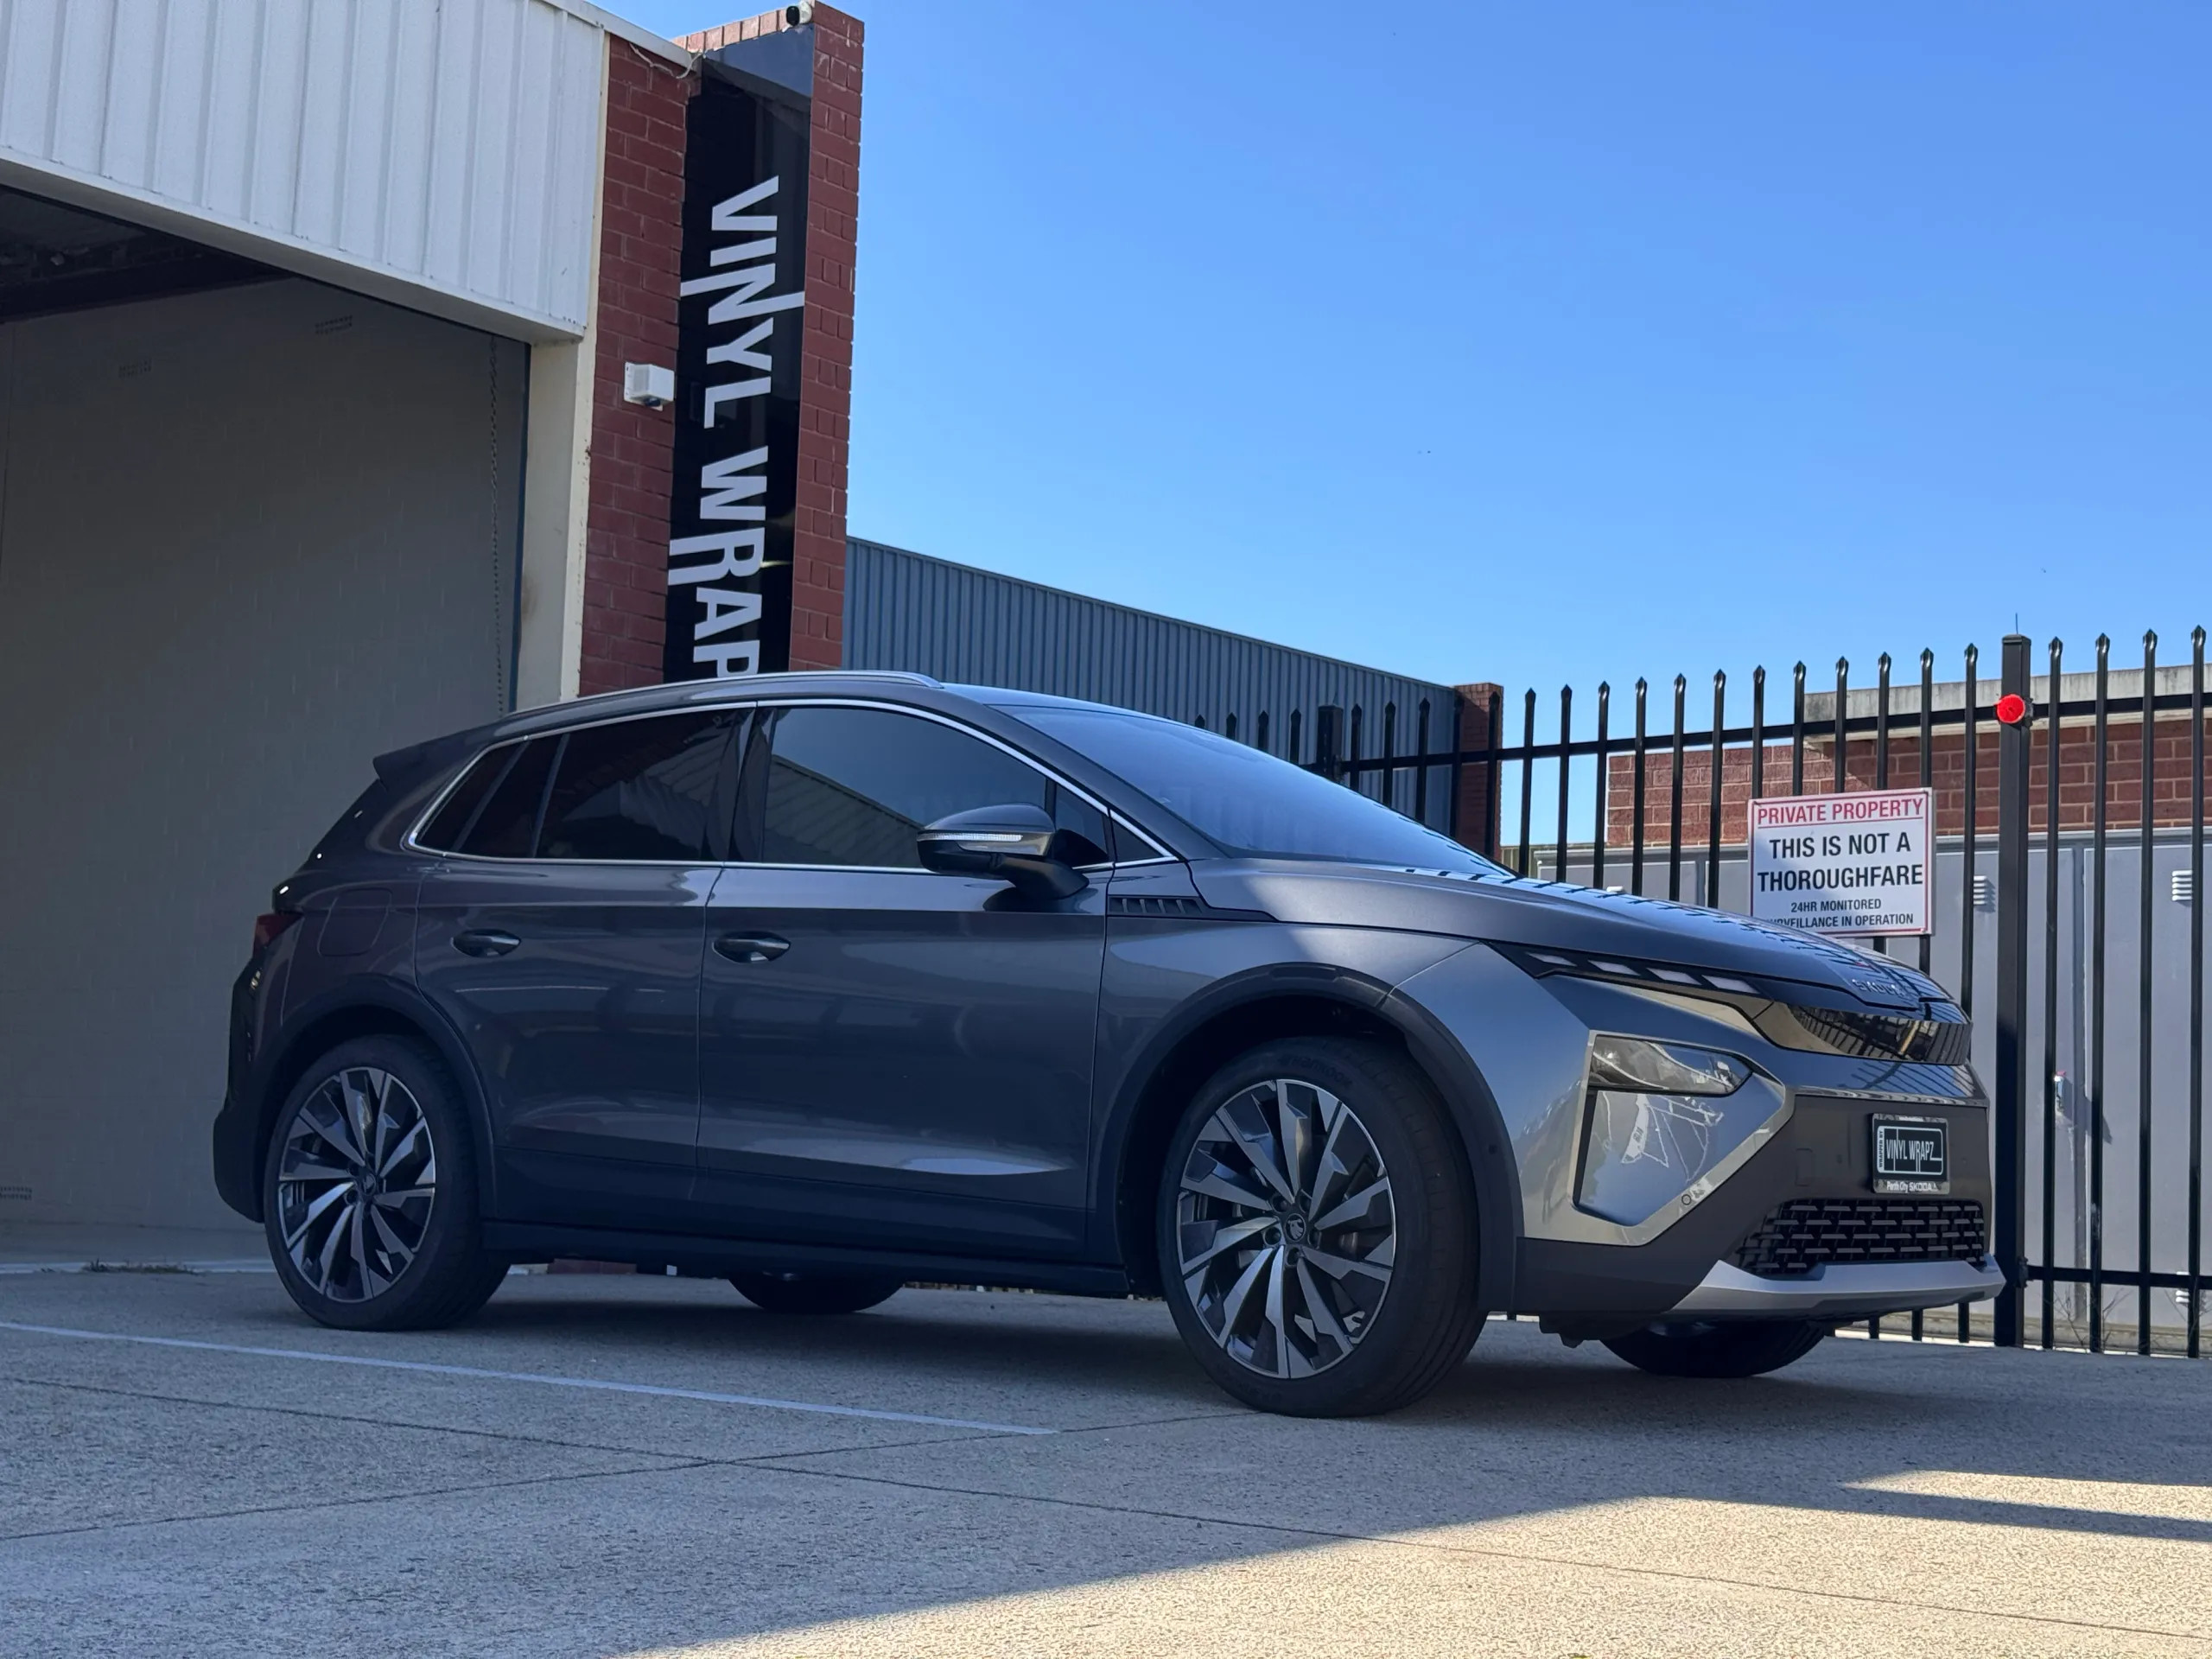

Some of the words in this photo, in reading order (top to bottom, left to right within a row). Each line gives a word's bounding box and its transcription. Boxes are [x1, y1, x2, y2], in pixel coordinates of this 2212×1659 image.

[680, 175, 805, 429] VINYL
[1758, 804, 1826, 825] PRIVATE
[1833, 798, 1923, 820] PROPERTY
[1769, 836, 1815, 860] THIS
[1822, 836, 1841, 856] IS
[1848, 833, 1890, 855] NOT
[1896, 831, 1911, 853] A
[1758, 864, 1923, 892] THOROUGHFARE
[1790, 901, 1818, 913] 24HR
[1820, 898, 1882, 912] MONITORED
[1841, 915, 1852, 926] IN
[1854, 913, 1914, 926] OPERATION
